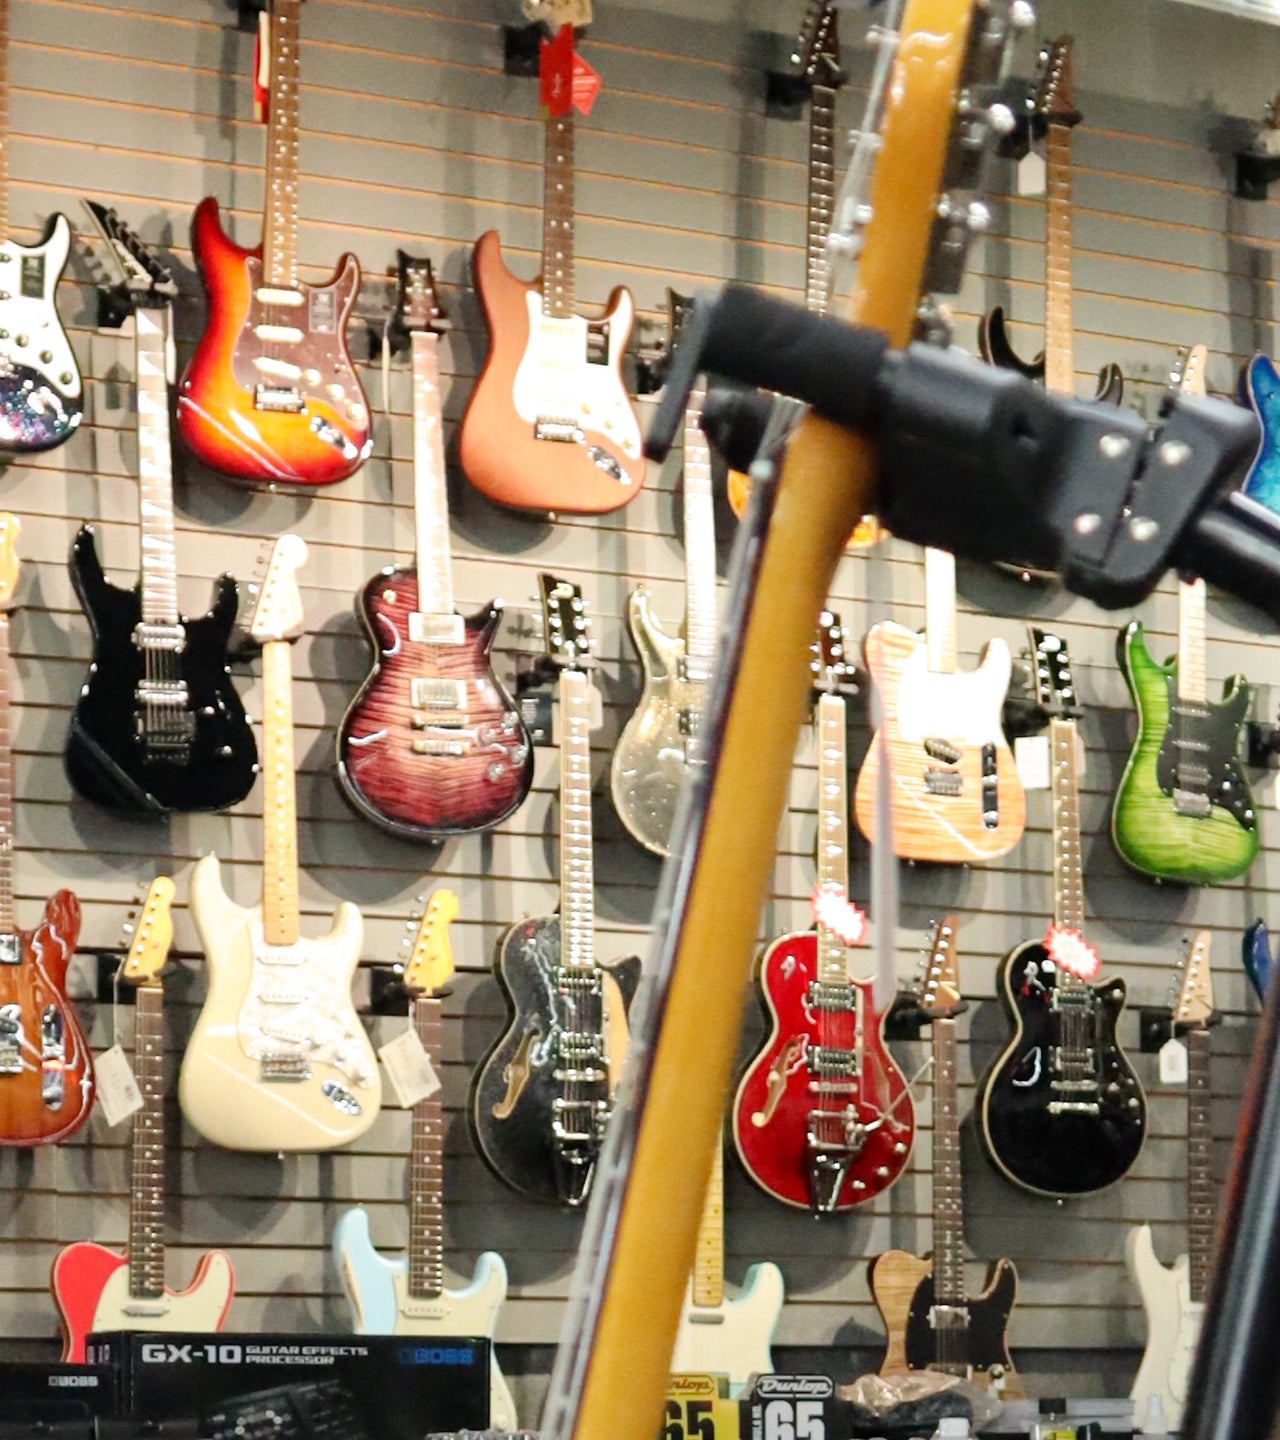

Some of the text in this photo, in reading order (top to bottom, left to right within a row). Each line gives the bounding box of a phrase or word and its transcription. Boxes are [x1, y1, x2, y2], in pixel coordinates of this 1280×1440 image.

[141, 1343, 242, 1365] GX-10
[245, 1345, 369, 1357] GUITAR EFFECTS
[413, 1347, 475, 1366] BOSS
[245, 1356, 335, 1365] PROCESSOR
[58, 1375, 99, 1387] BOSS
[761, 1378, 829, 1395] Dunlop
